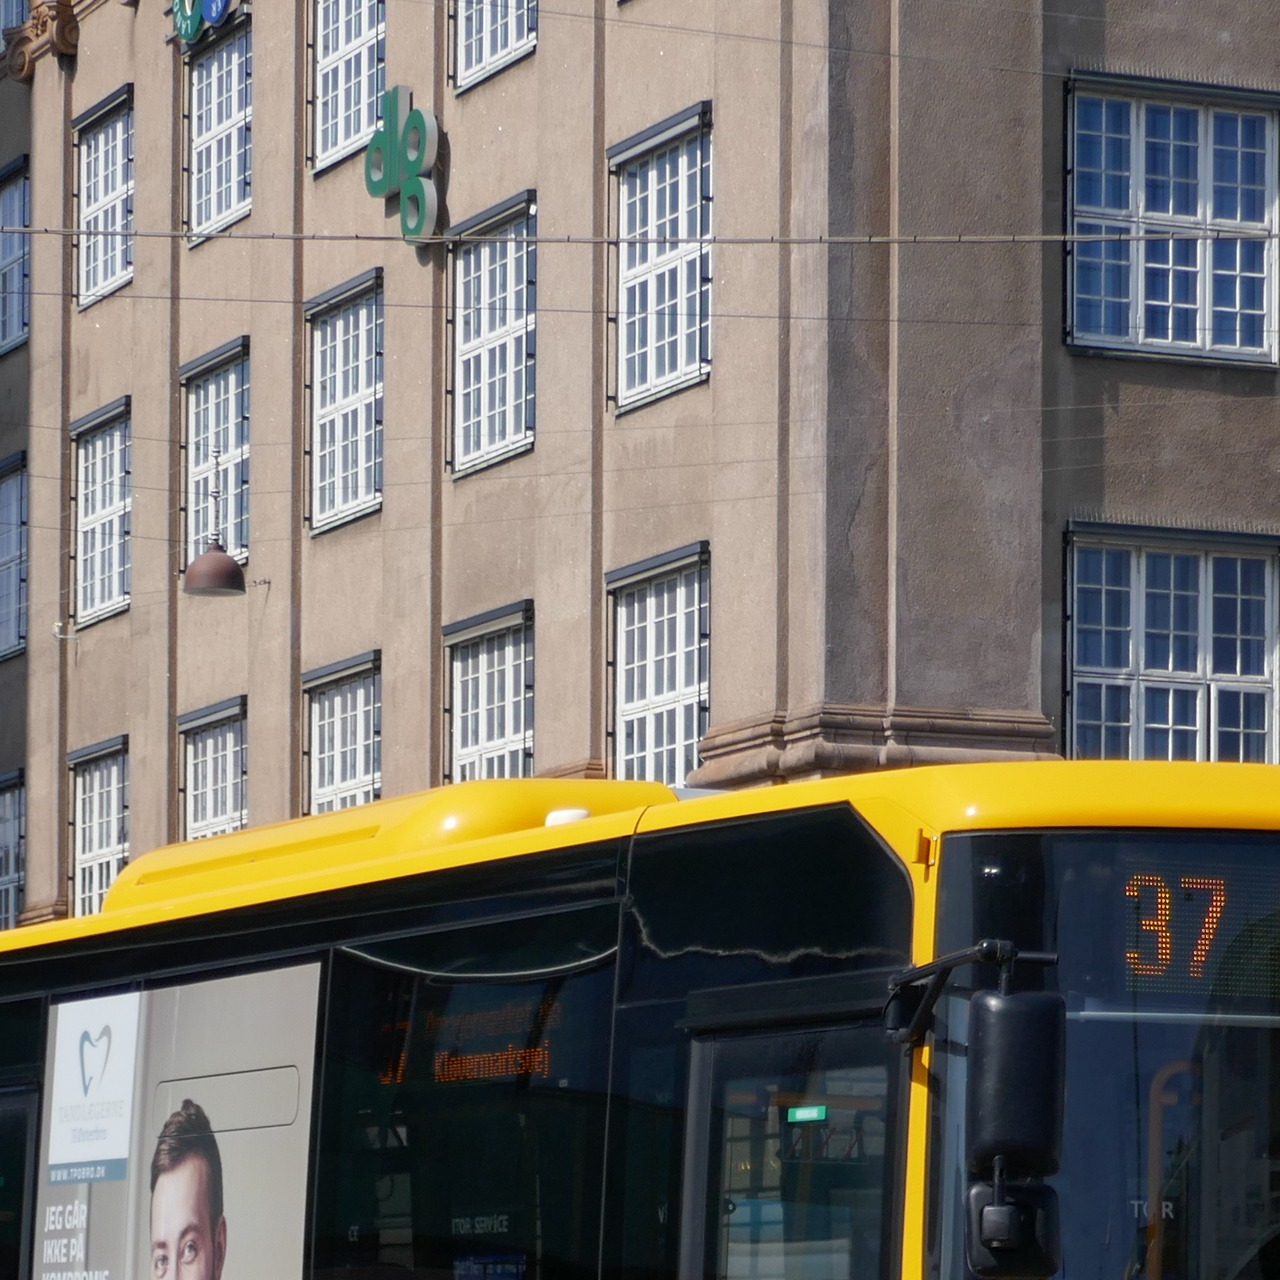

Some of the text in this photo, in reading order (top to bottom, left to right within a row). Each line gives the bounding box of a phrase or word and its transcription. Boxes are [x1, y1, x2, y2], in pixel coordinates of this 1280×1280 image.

[1124, 873, 1228, 979] 37
[44, 1200, 87, 1232] JEG GÅR
[43, 1233, 84, 1263] IKKE PÅ
